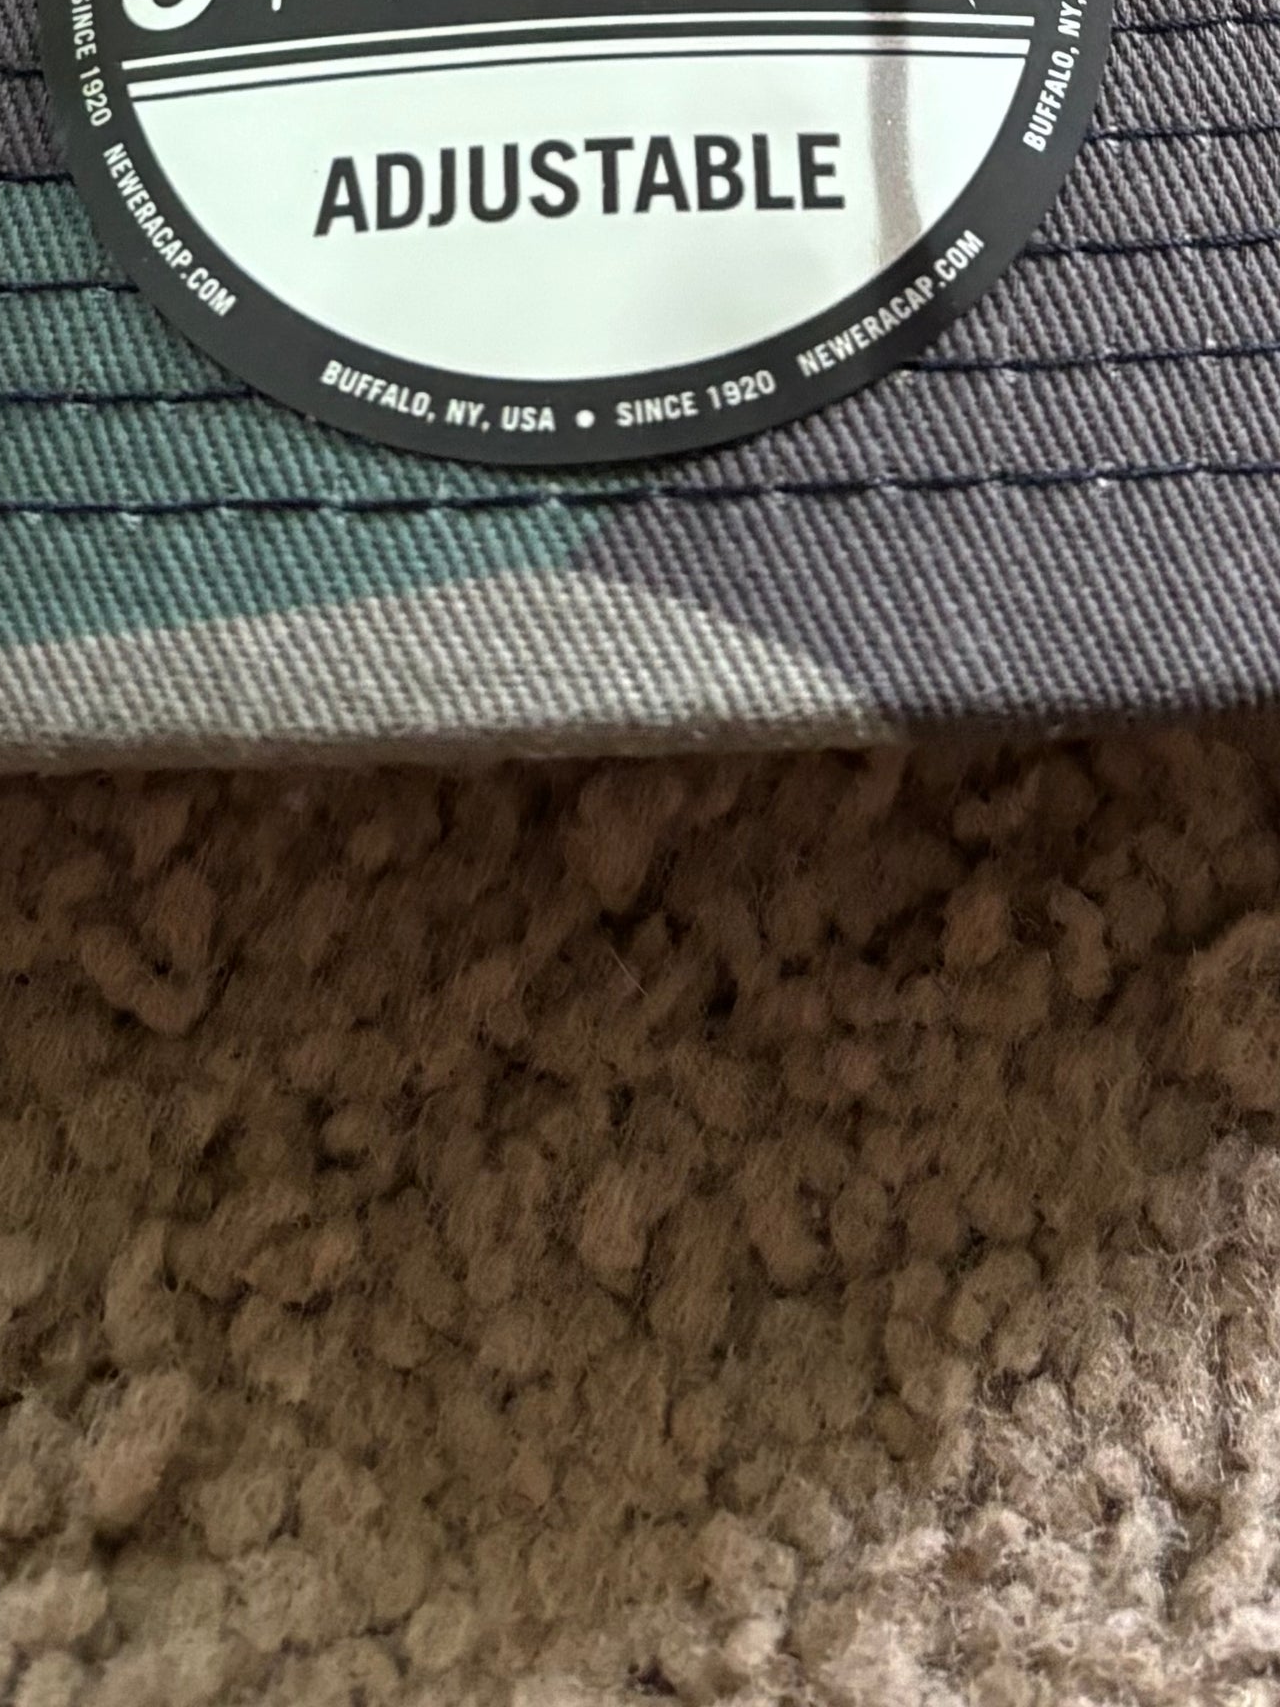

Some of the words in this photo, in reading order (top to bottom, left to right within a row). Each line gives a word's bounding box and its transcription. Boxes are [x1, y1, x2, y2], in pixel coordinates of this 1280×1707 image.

[1022, 47, 1080, 153] BUFFALO,
[79, 66, 113, 127] 1920
[102, 142, 238, 317] NEWERACAP.COM
[313, 132, 846, 237] ADJUSTABLE
[320, 359, 437, 424] BUFFALO,
[445, 398, 491, 433] NY,
[500, 405, 556, 432] USA
[615, 390, 699, 428] SINCE
[705, 369, 776, 410] 1920
[795, 228, 985, 377] NEWERACAP.COM
